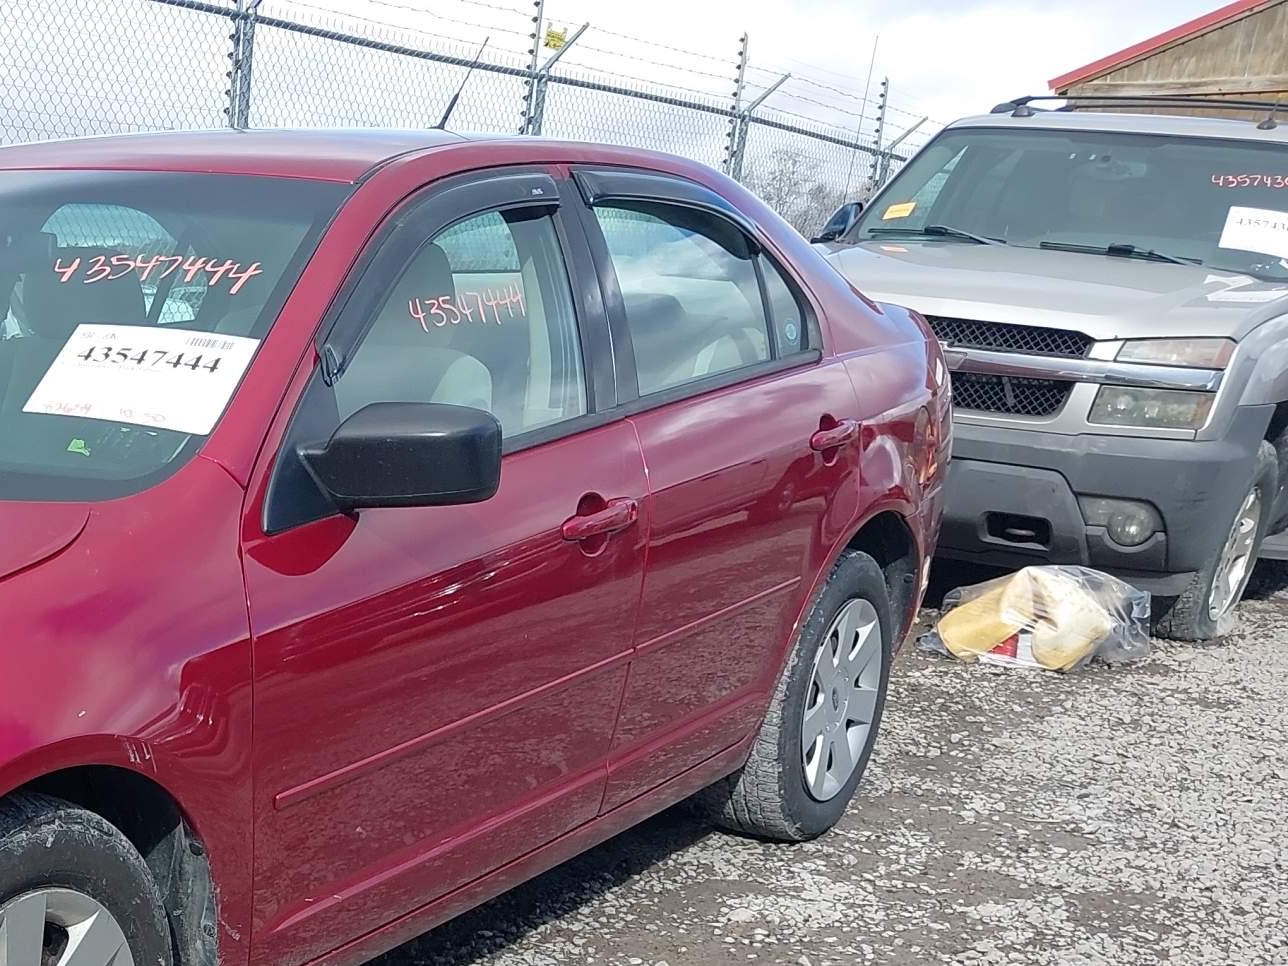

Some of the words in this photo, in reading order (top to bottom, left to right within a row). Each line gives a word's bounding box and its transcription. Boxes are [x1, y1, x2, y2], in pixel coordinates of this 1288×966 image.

[54, 254, 263, 294] 43547444
[408, 281, 526, 333] 43547444
[77, 345, 222, 374] 43547444
